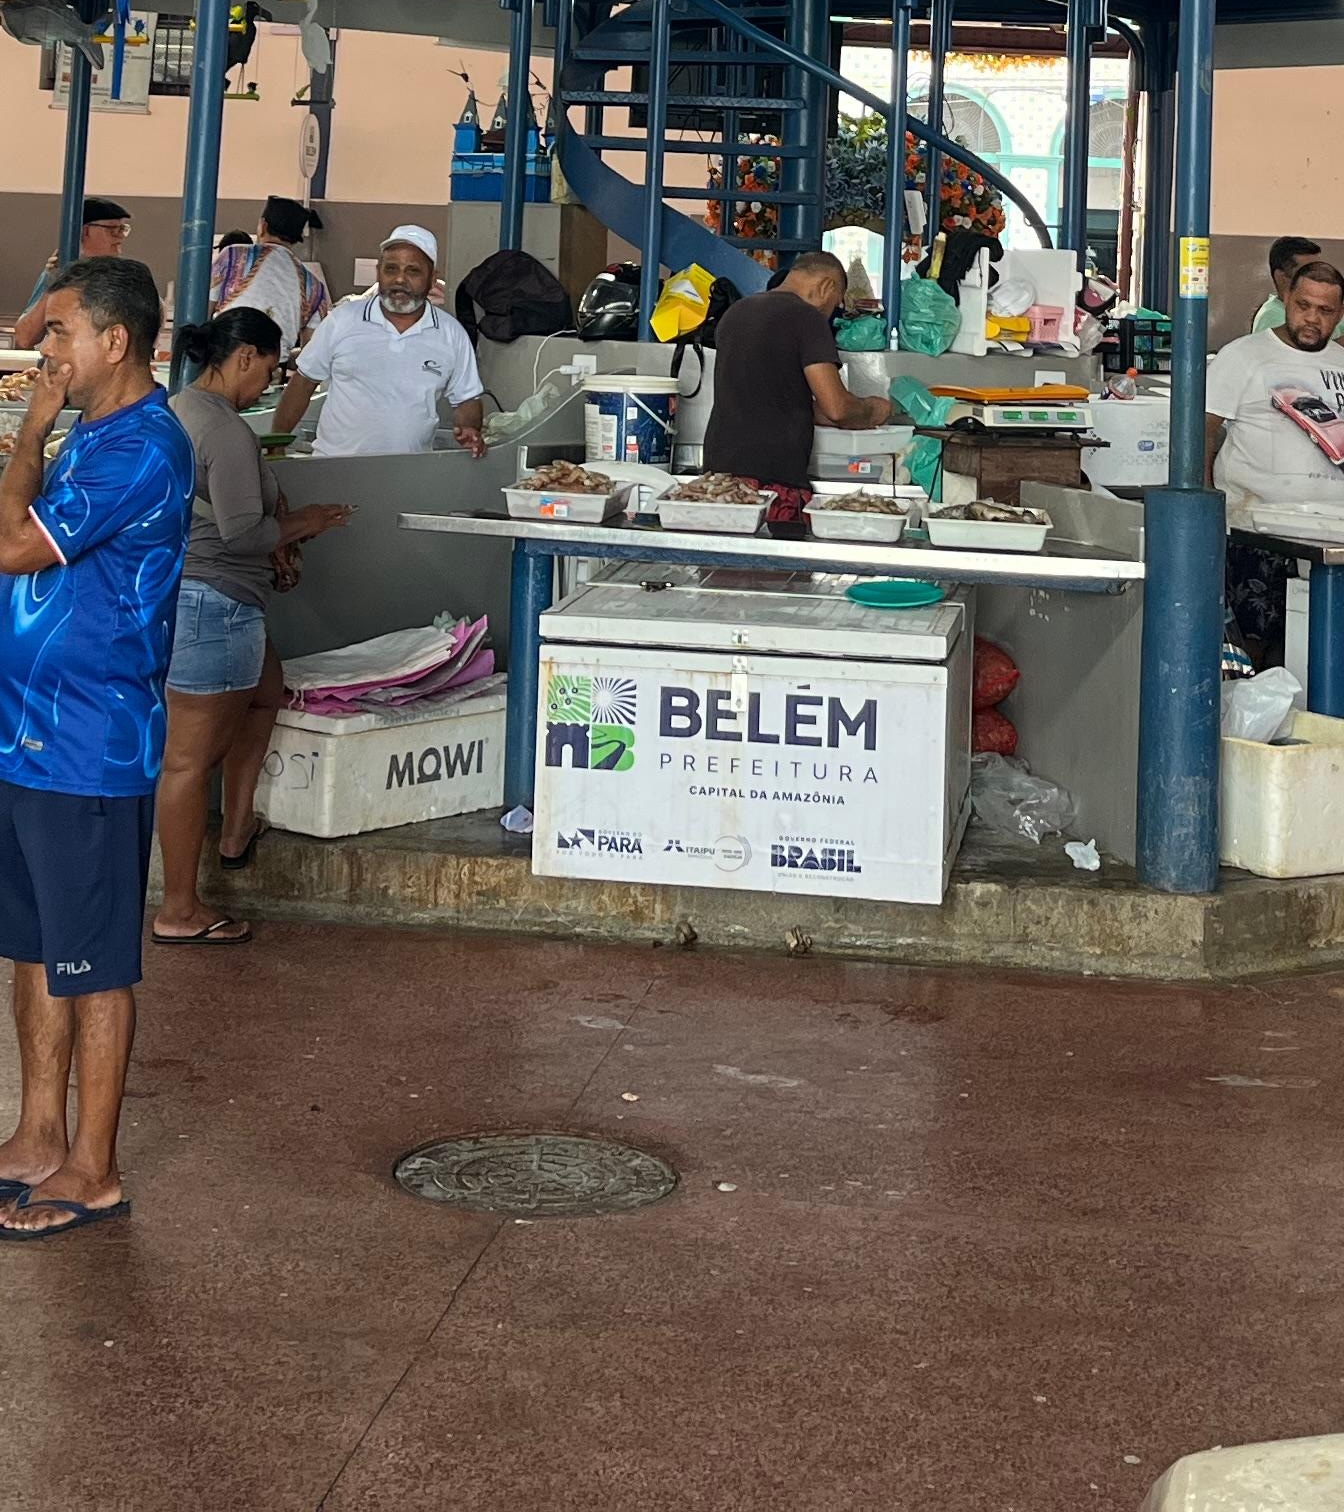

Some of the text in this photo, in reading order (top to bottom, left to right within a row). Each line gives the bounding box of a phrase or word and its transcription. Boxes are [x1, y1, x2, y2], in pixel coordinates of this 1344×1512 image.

[659, 684, 877, 751] BELÉM
[386, 739, 483, 790] MOWI
[660, 753, 878, 783] PREFEITURA
[689, 785, 845, 805] CAPITAL DA AMAZÔNIA
[598, 835, 643, 853] PARÁ
[771, 844, 861, 873] BRASIL
[57, 960, 91, 975] FILA
